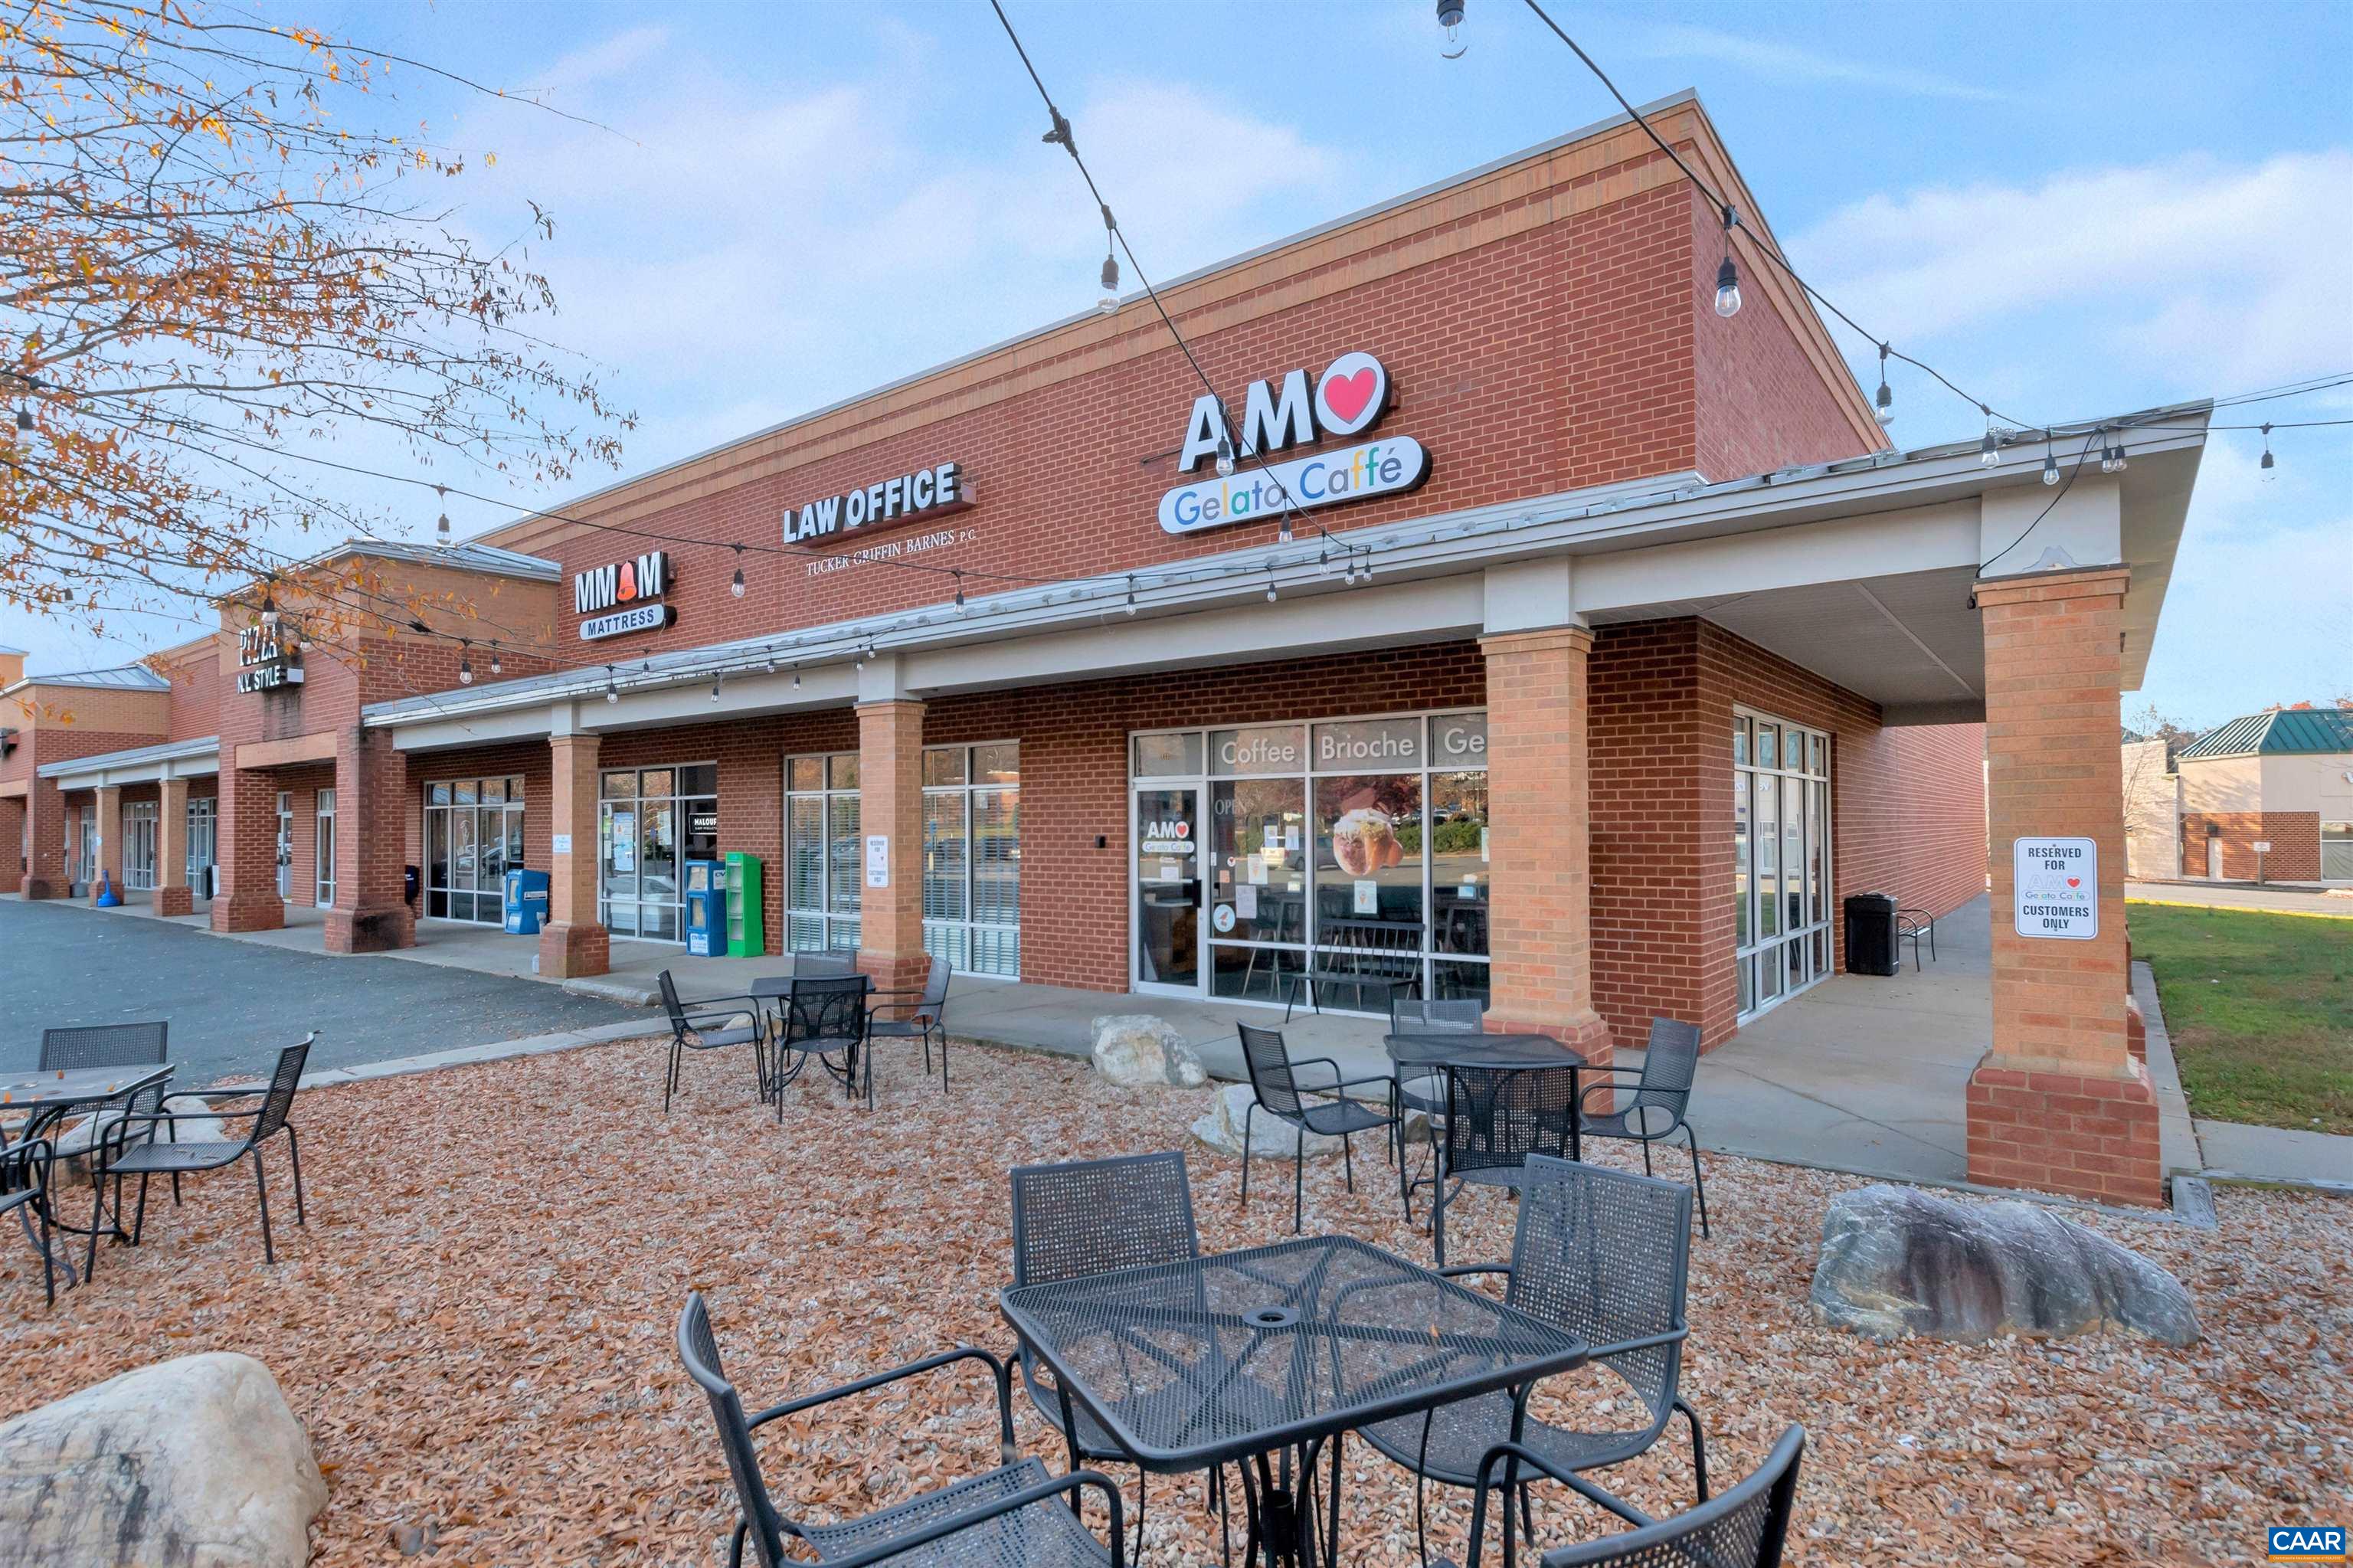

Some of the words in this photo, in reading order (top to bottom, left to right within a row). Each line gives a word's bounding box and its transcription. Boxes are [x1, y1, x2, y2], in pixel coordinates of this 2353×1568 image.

[1178, 352, 1388, 473] AMO
[1174, 480, 1284, 525] Gelato
[1299, 447, 1402, 499] Caffé
[784, 496, 841, 544] LAW
[846, 462, 954, 527] OFFICE
[806, 555, 849, 576] TUCKER
[853, 542, 901, 565] GRIFFIN
[906, 529, 955, 553] BARNES
[587, 608, 655, 637] MATTRESS
[254, 665, 281, 690] STYLE
[1221, 741, 1296, 766] Coffee
[1320, 732, 1415, 761] Brioche
[2028, 847, 2082, 858] RESERVED
[2044, 860, 2066, 871] FOR
[2025, 891, 2056, 900] Gelato
[2022, 905, 2090, 918] CUSTOMERS
[2042, 918, 2070, 929] ONLY
